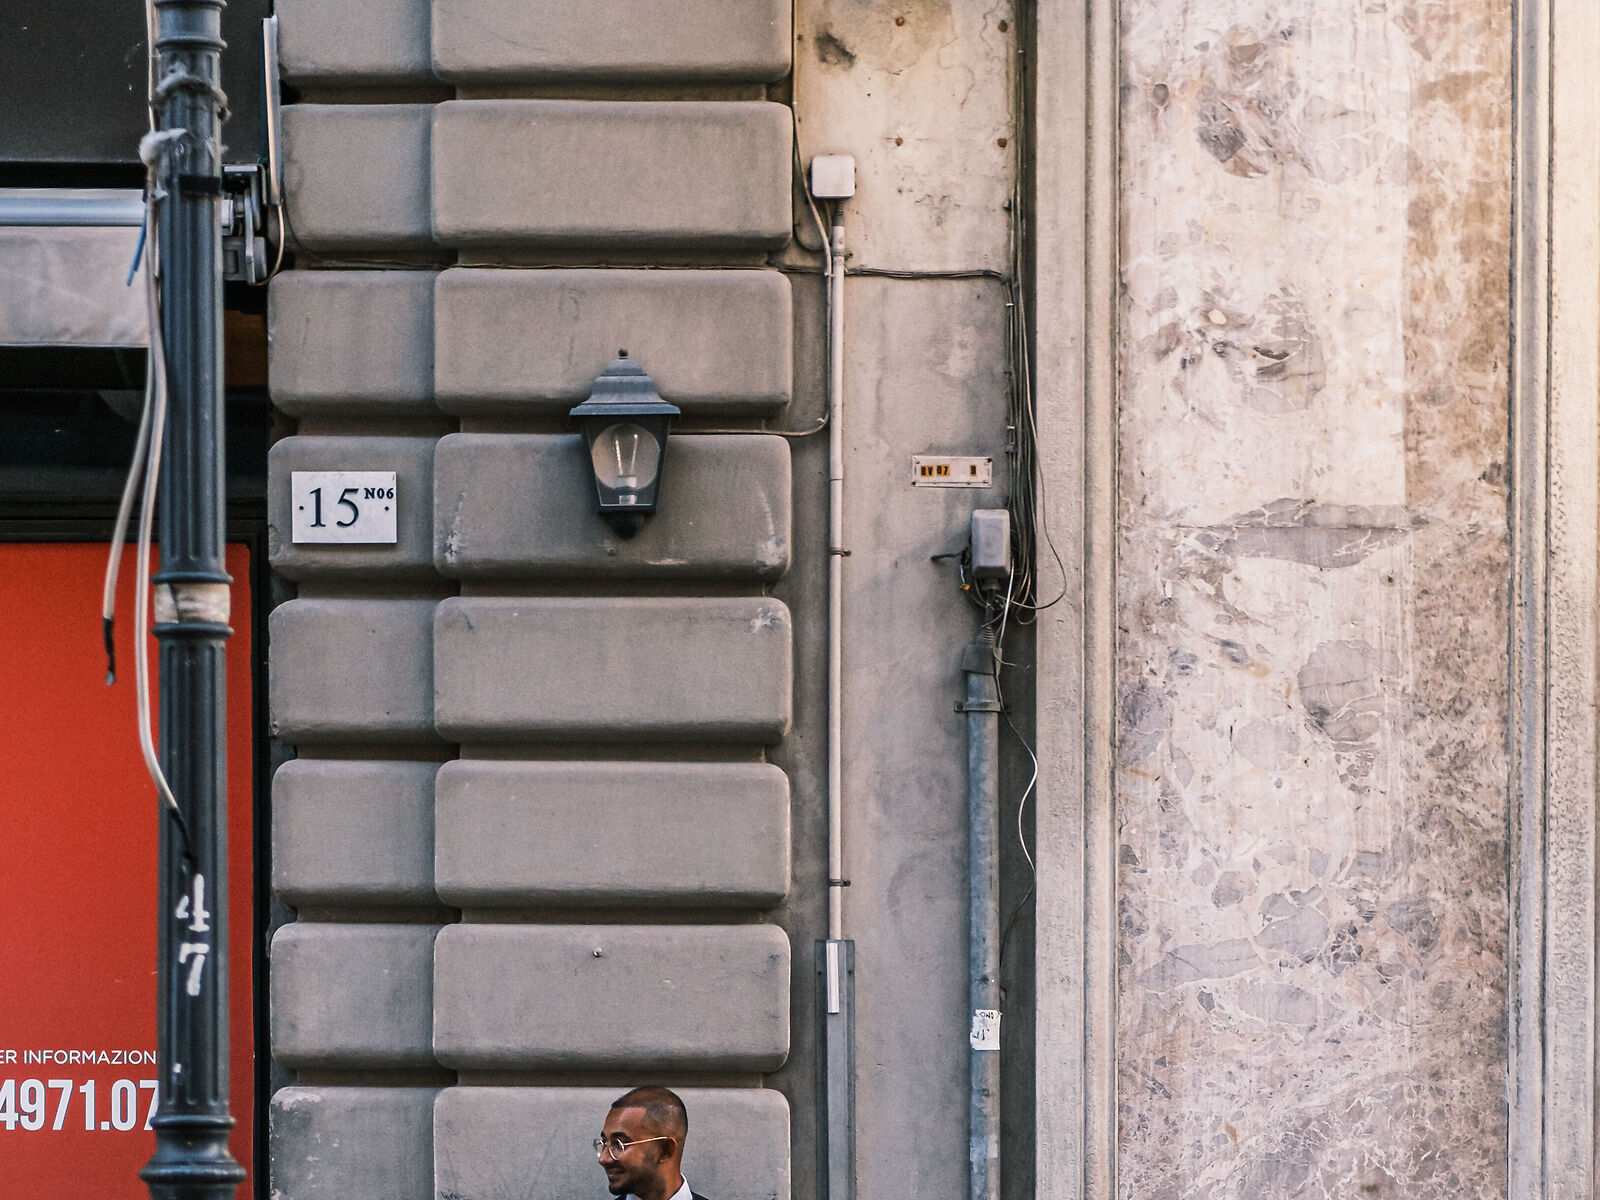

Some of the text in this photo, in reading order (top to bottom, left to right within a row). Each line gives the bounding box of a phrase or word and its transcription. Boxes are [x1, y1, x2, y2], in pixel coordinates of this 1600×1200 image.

[309, 487, 359, 528] 15
[24, 1049, 157, 1064] INFORMAZION
[0, 1078, 159, 1131] 4971.07
